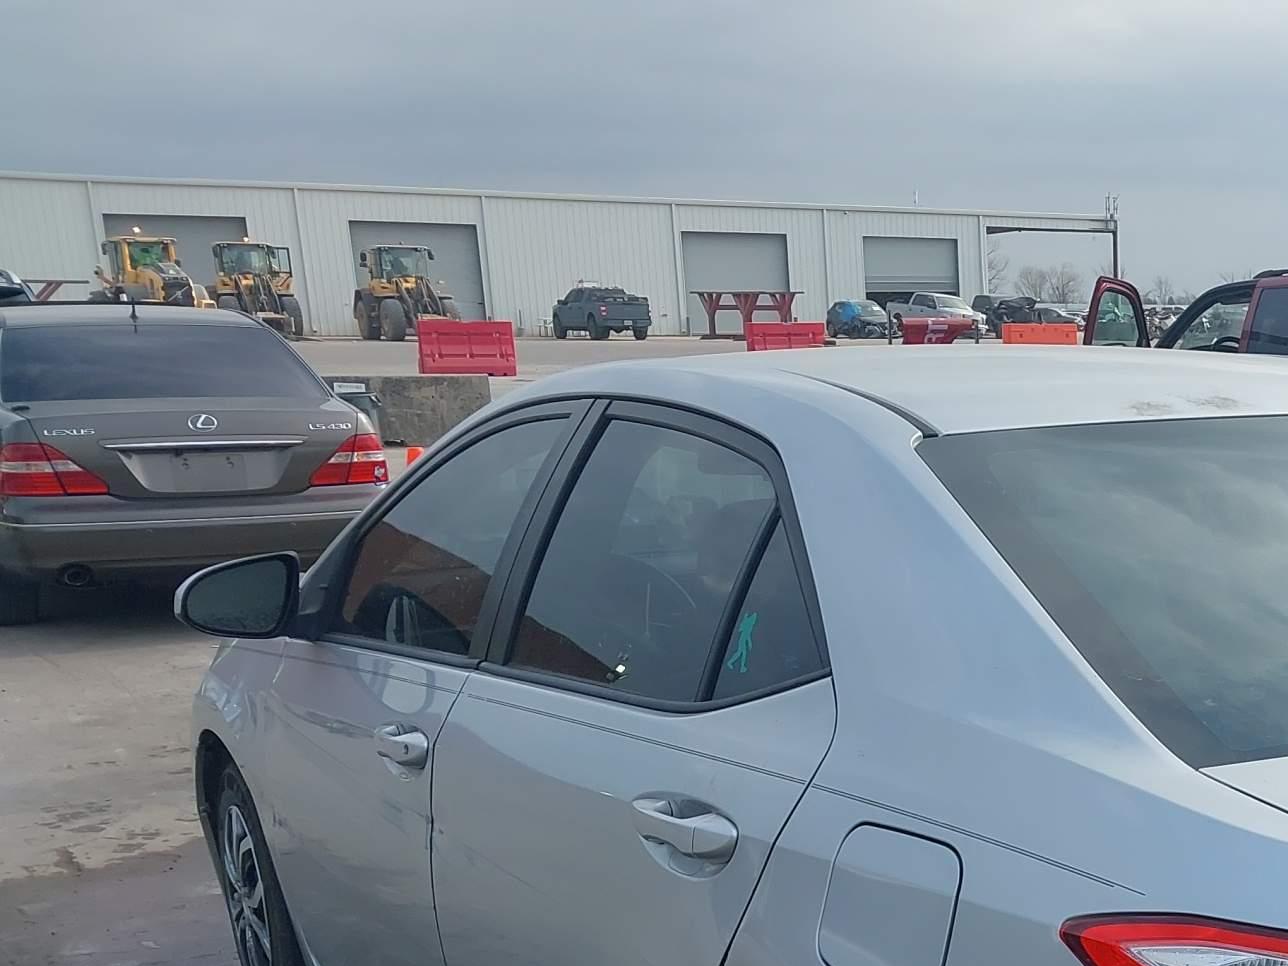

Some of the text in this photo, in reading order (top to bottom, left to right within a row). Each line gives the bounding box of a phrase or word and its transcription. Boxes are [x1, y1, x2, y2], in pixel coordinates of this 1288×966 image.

[308, 422, 352, 430] LS 430
[43, 428, 96, 436] LEXUS
